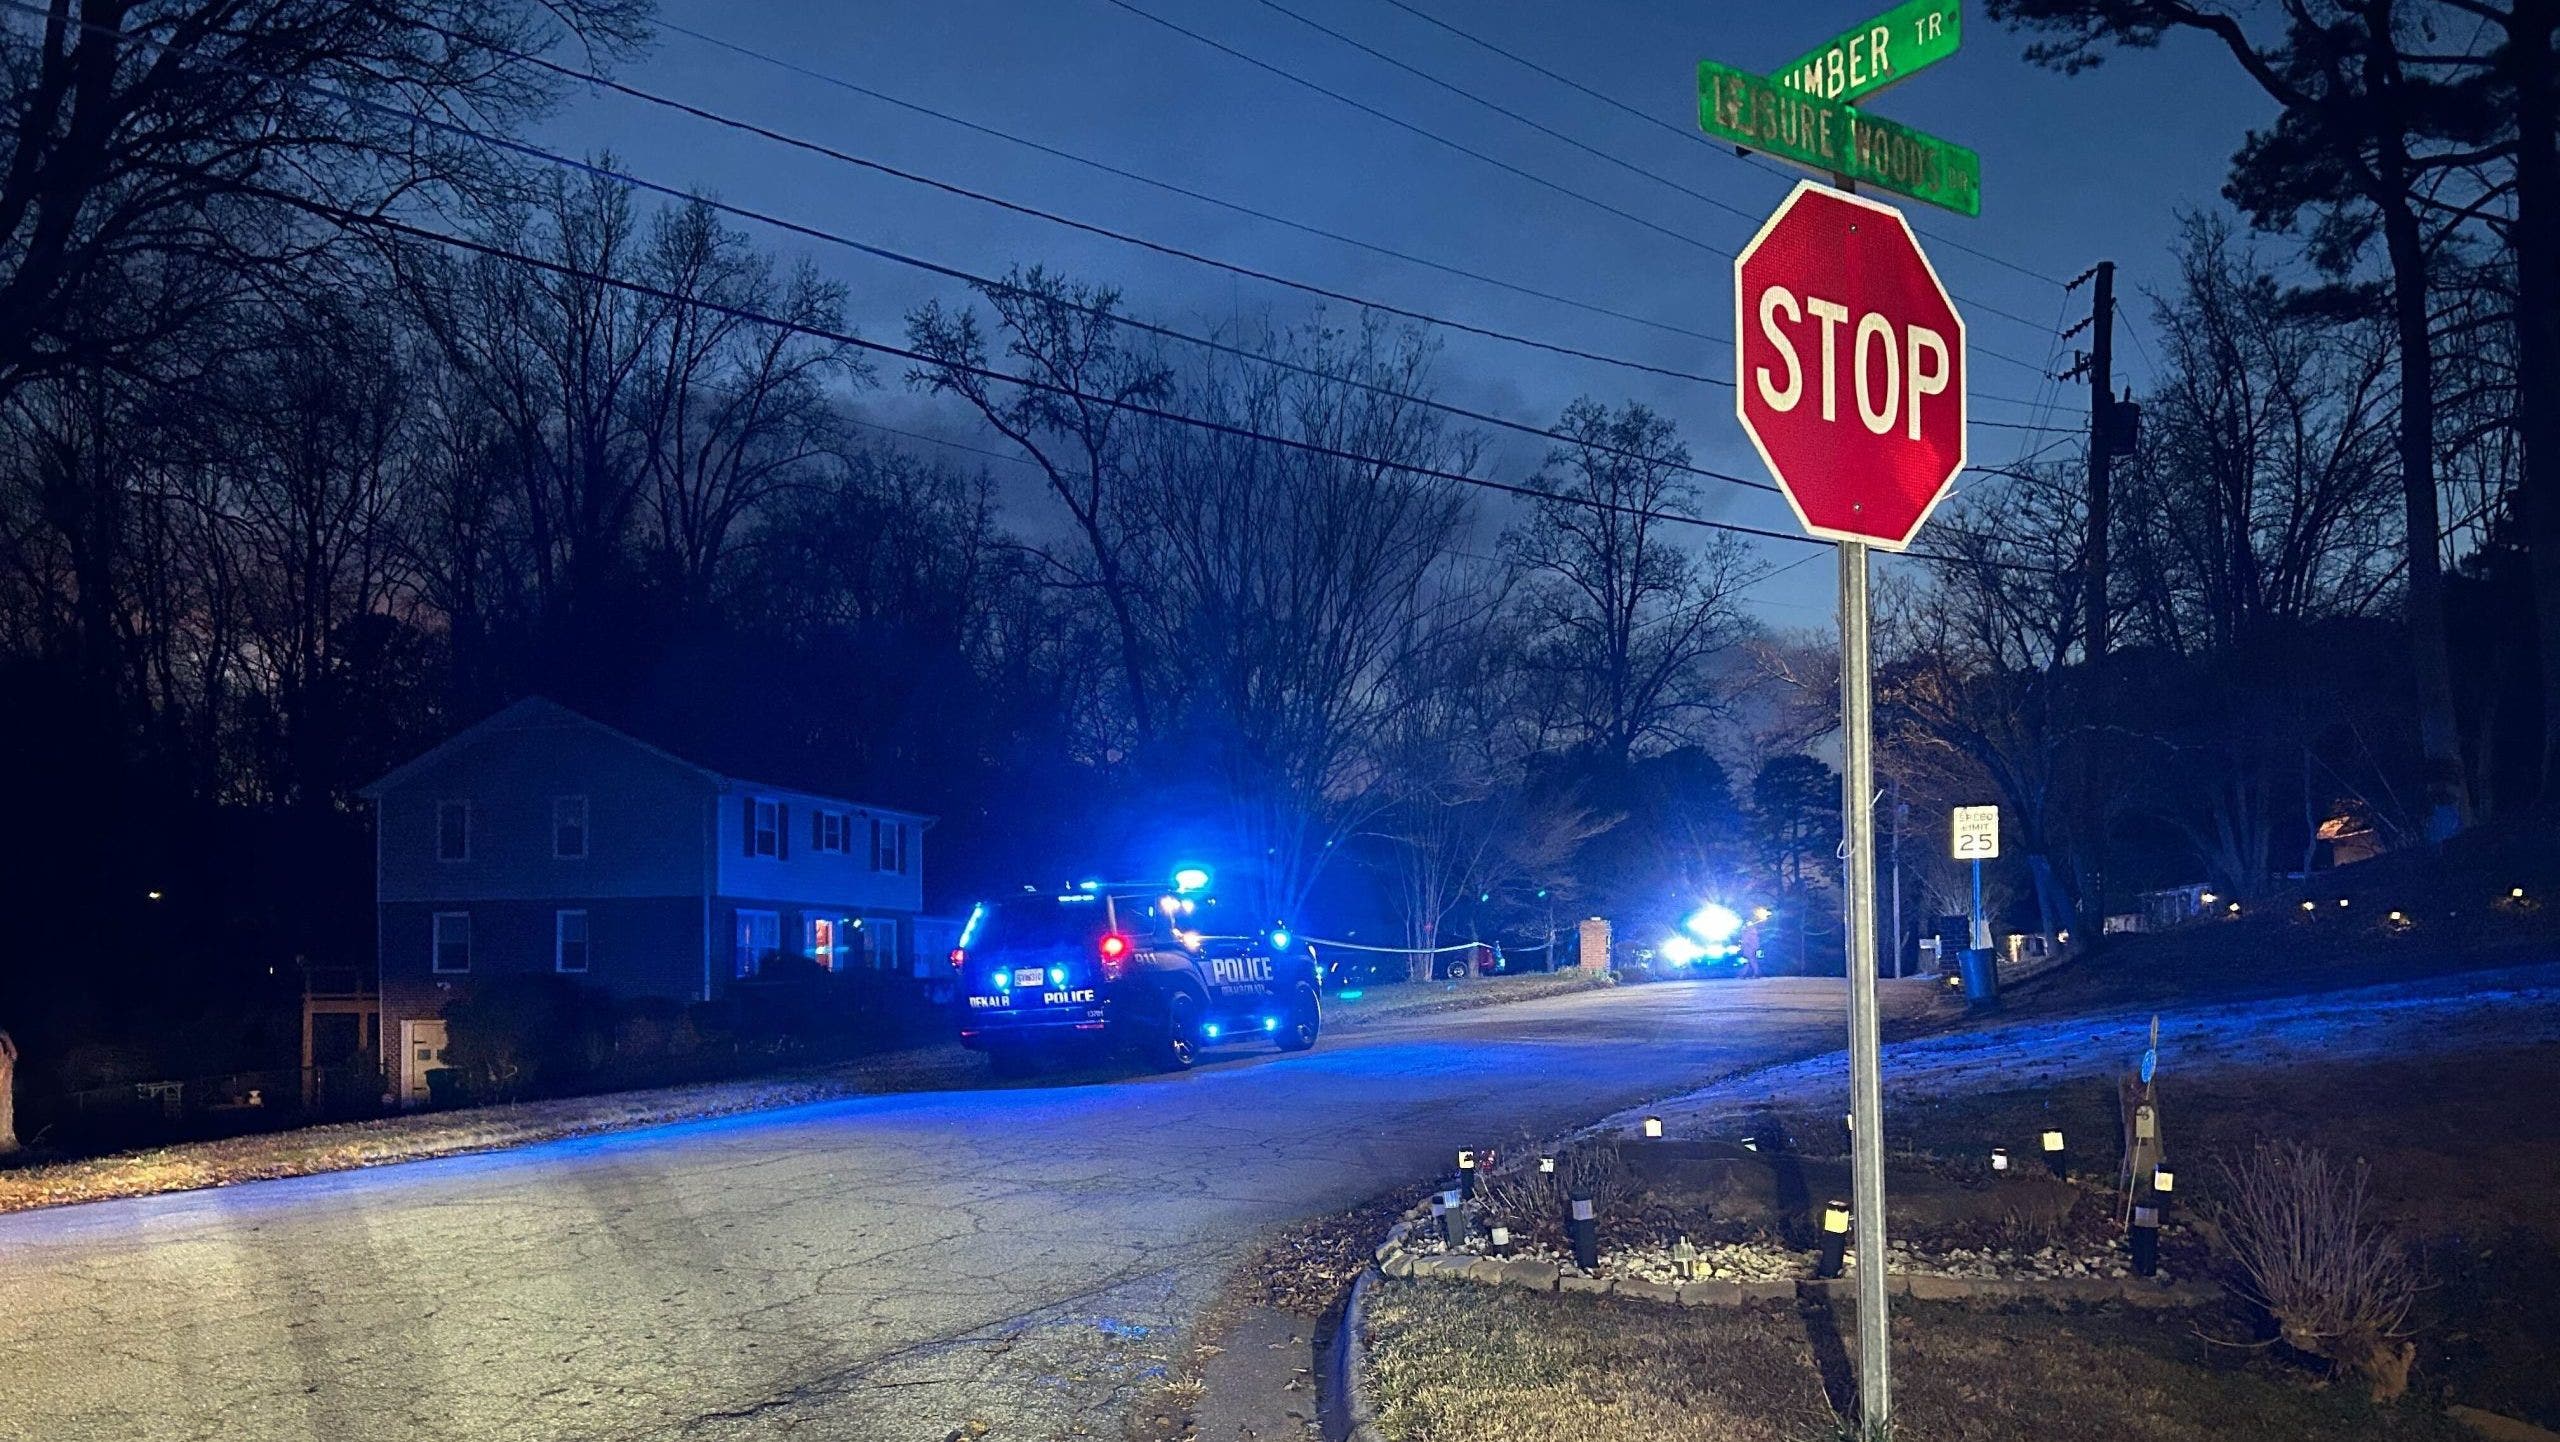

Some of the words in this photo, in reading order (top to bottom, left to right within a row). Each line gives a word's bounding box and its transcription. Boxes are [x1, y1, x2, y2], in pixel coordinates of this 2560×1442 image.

[1914, 12, 1942, 46] TR
[1713, 75, 1834, 158] LEISURE
[1850, 117, 1941, 193] WOODS
[1756, 285, 1949, 441] STOP
[1962, 823, 1989, 832] LIMIT
[1960, 833, 1992, 851] 25
[1211, 956, 1274, 984] POLICE
[969, 995, 1010, 1009] DEKALB
[1044, 989, 1095, 1005] POLICE
